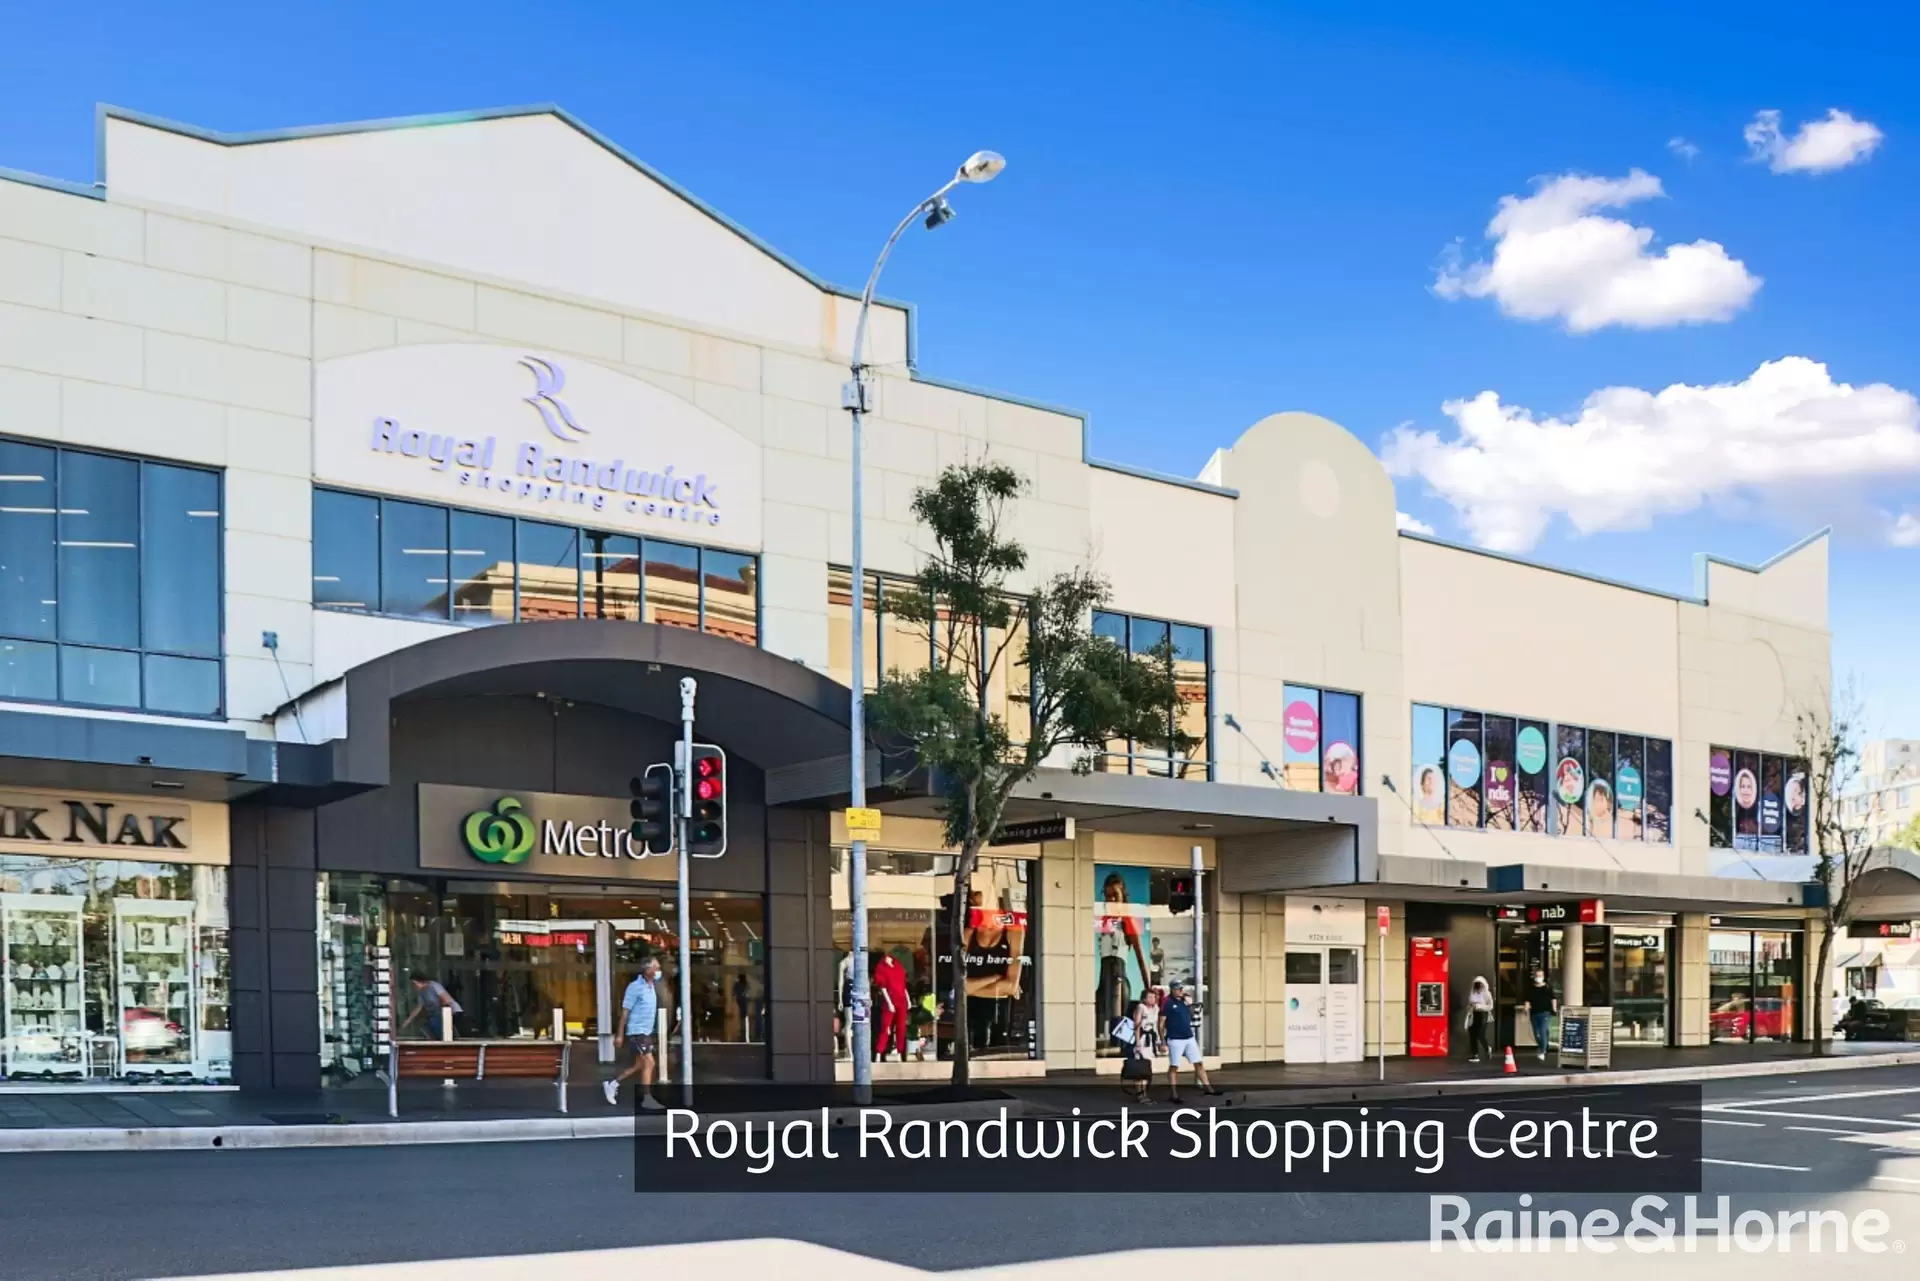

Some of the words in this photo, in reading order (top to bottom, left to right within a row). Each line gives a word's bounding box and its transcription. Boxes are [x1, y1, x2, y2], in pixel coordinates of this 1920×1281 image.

[371, 415, 496, 472] Royal
[516, 441, 720, 509] Randwick
[459, 470, 606, 512] shopping
[625, 499, 721, 526] centre
[61, 800, 187, 849] NAK
[543, 819, 650, 860] Metro
[1541, 904, 1566, 919] nab
[986, 954, 1014, 964] bare
